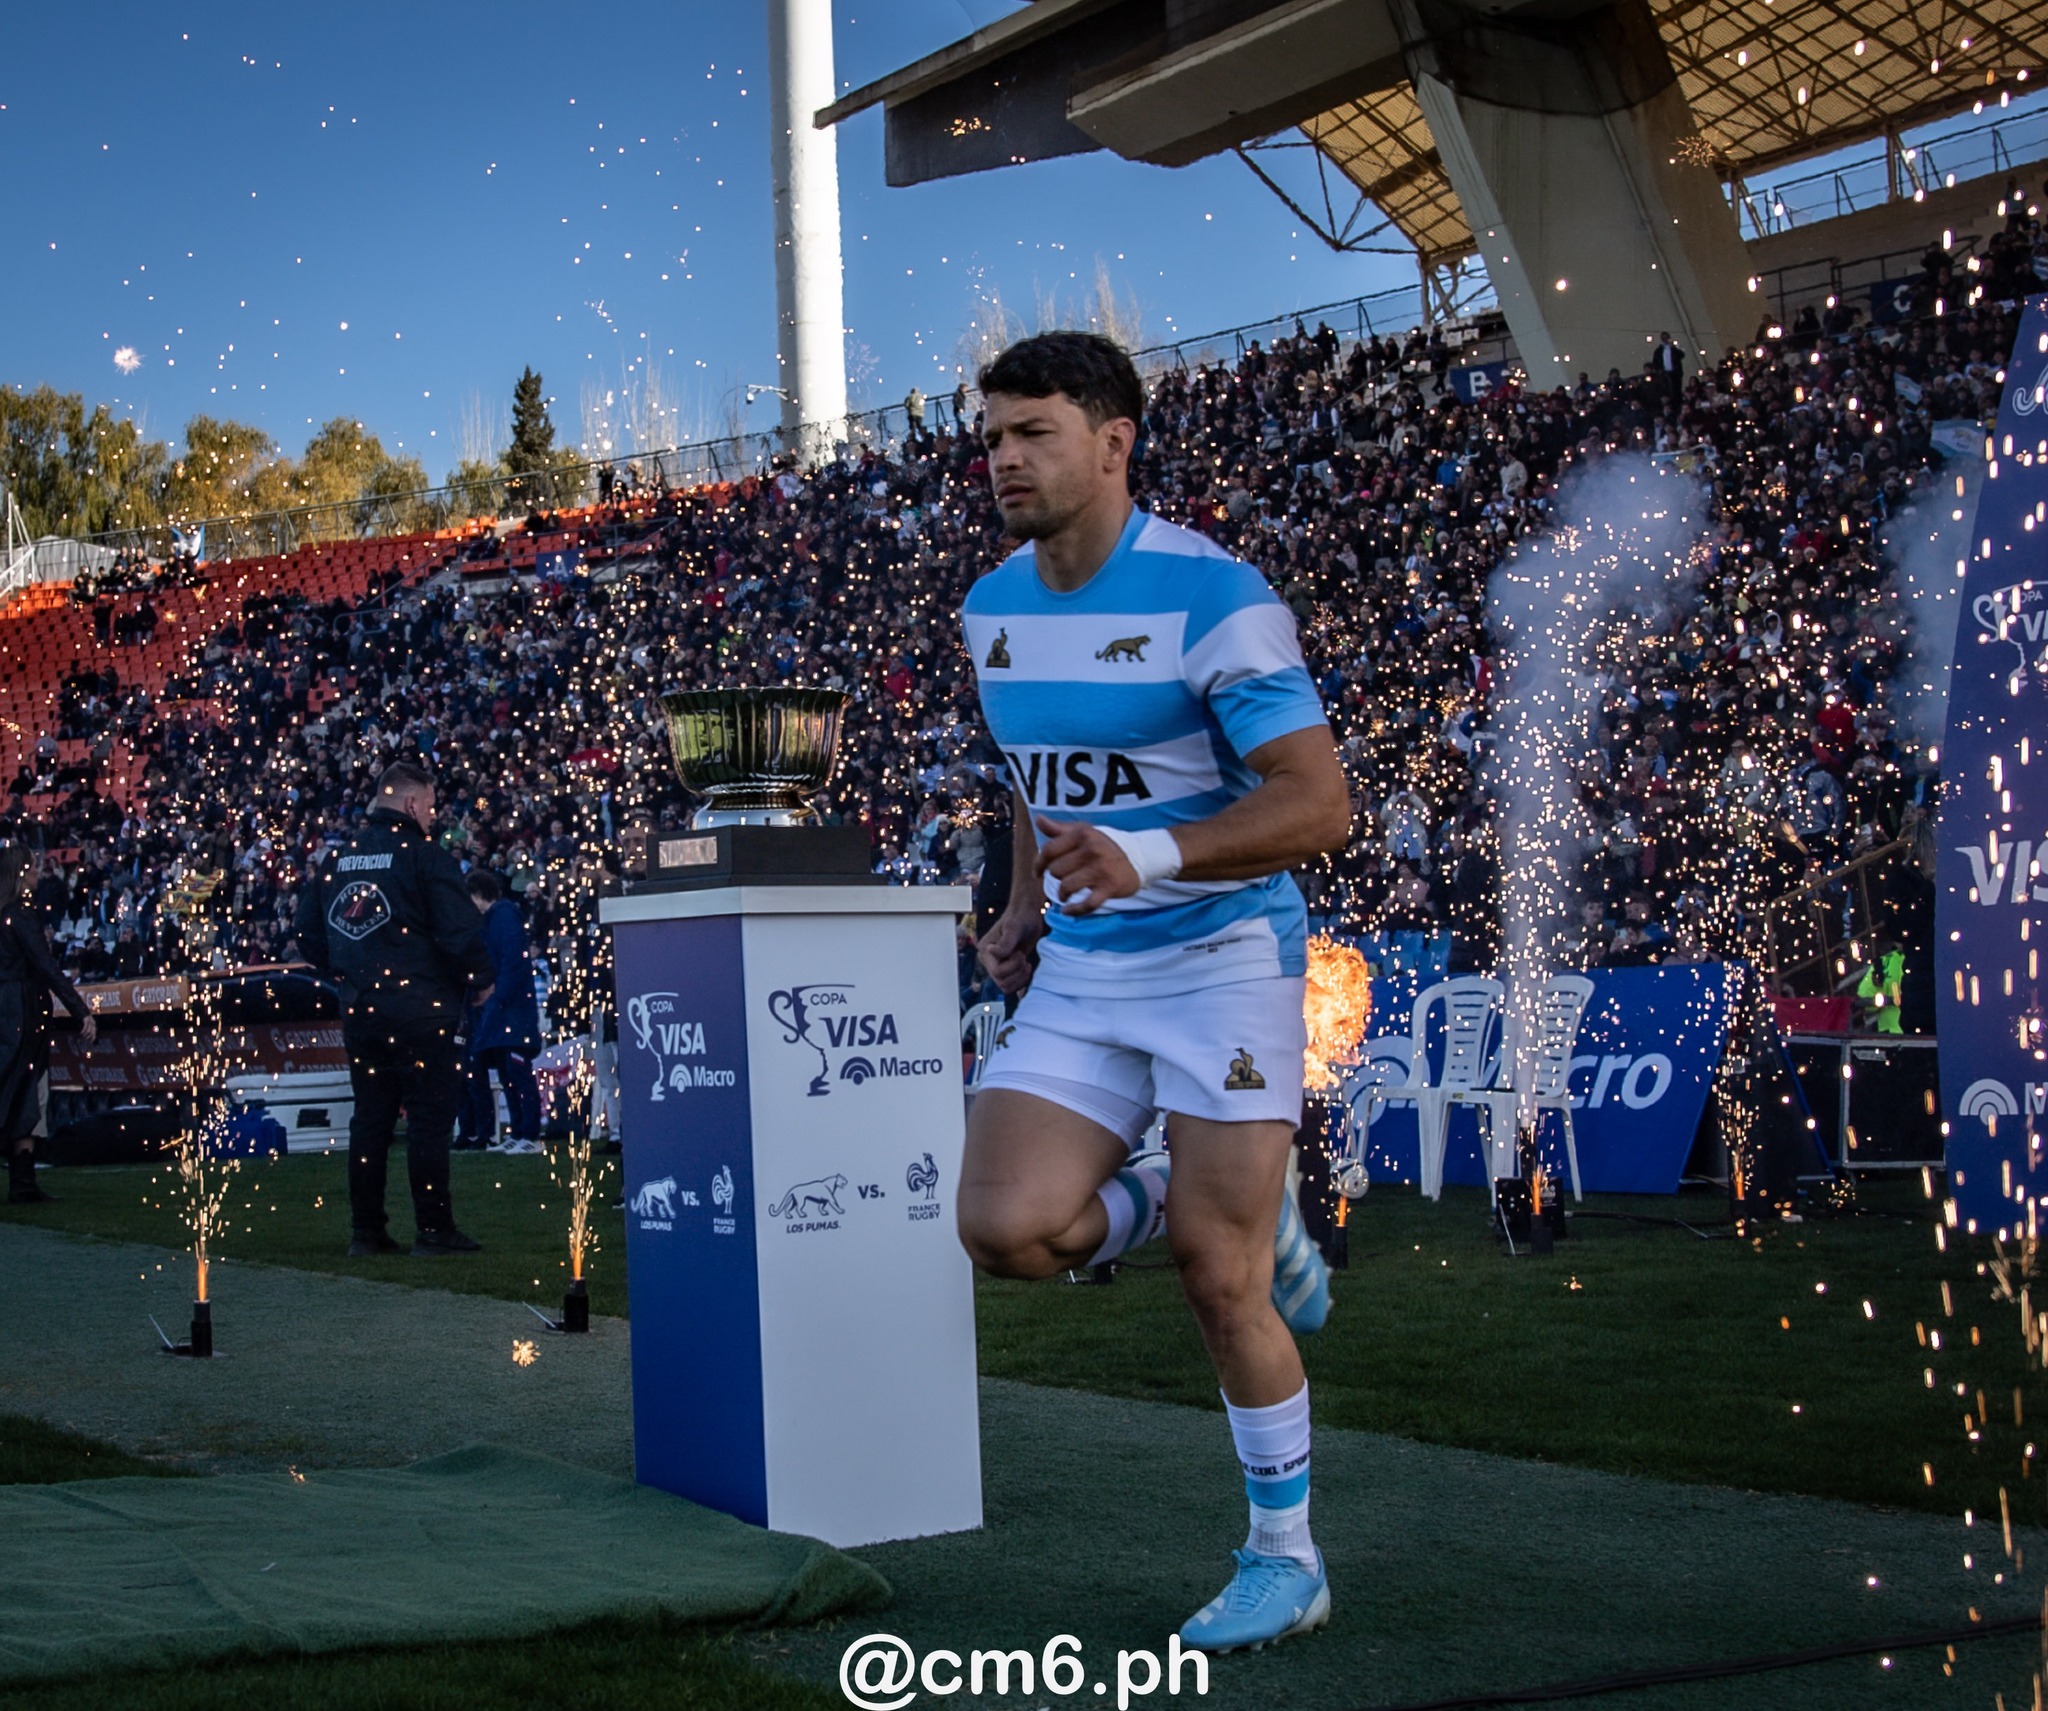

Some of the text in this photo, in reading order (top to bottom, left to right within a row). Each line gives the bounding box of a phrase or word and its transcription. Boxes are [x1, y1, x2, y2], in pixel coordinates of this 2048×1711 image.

[1468, 370, 1491, 398] B
[554, 557, 570, 579] A
[1004, 751, 1153, 806] VISA
[336, 853, 393, 872] PREVENCION
[651, 1000, 674, 1013] COPA
[810, 993, 847, 1005] COPA
[656, 1022, 707, 1055] VISA
[818, 1014, 899, 1048] VISA
[880, 1056, 943, 1077] Macro
[693, 1066, 735, 1087] Macro
[908, 1203, 941, 1212] FRANCE
[713, 1217, 735, 1226] FRANCE
[908, 1211, 941, 1221] RUGBY
[640, 1220, 652, 1230] LOS
[713, 1225, 735, 1235] RUGBY
[786, 1223, 803, 1234] LOS
